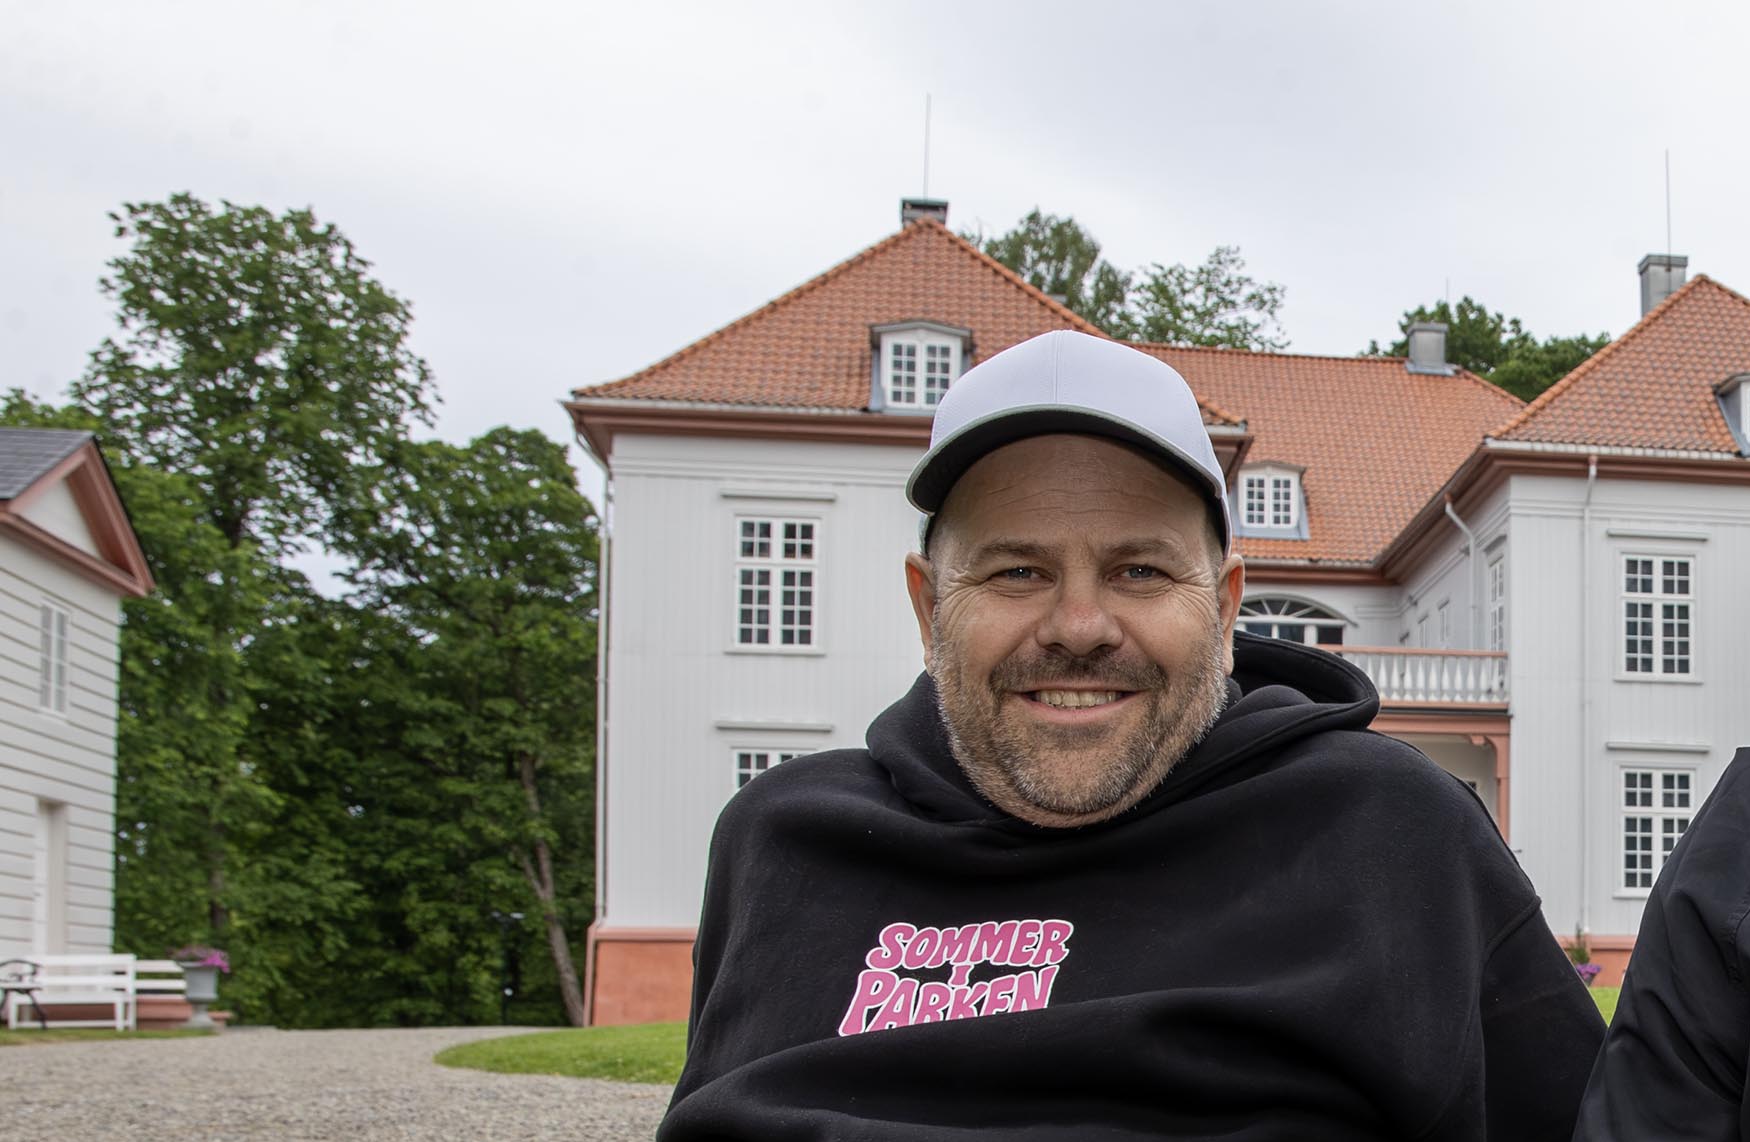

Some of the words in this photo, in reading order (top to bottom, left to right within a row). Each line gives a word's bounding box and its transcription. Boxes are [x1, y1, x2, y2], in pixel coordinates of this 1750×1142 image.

[866, 919, 1074, 970] SOMMER
[838, 965, 1060, 1037] PARKEN
[949, 964, 974, 988] I
